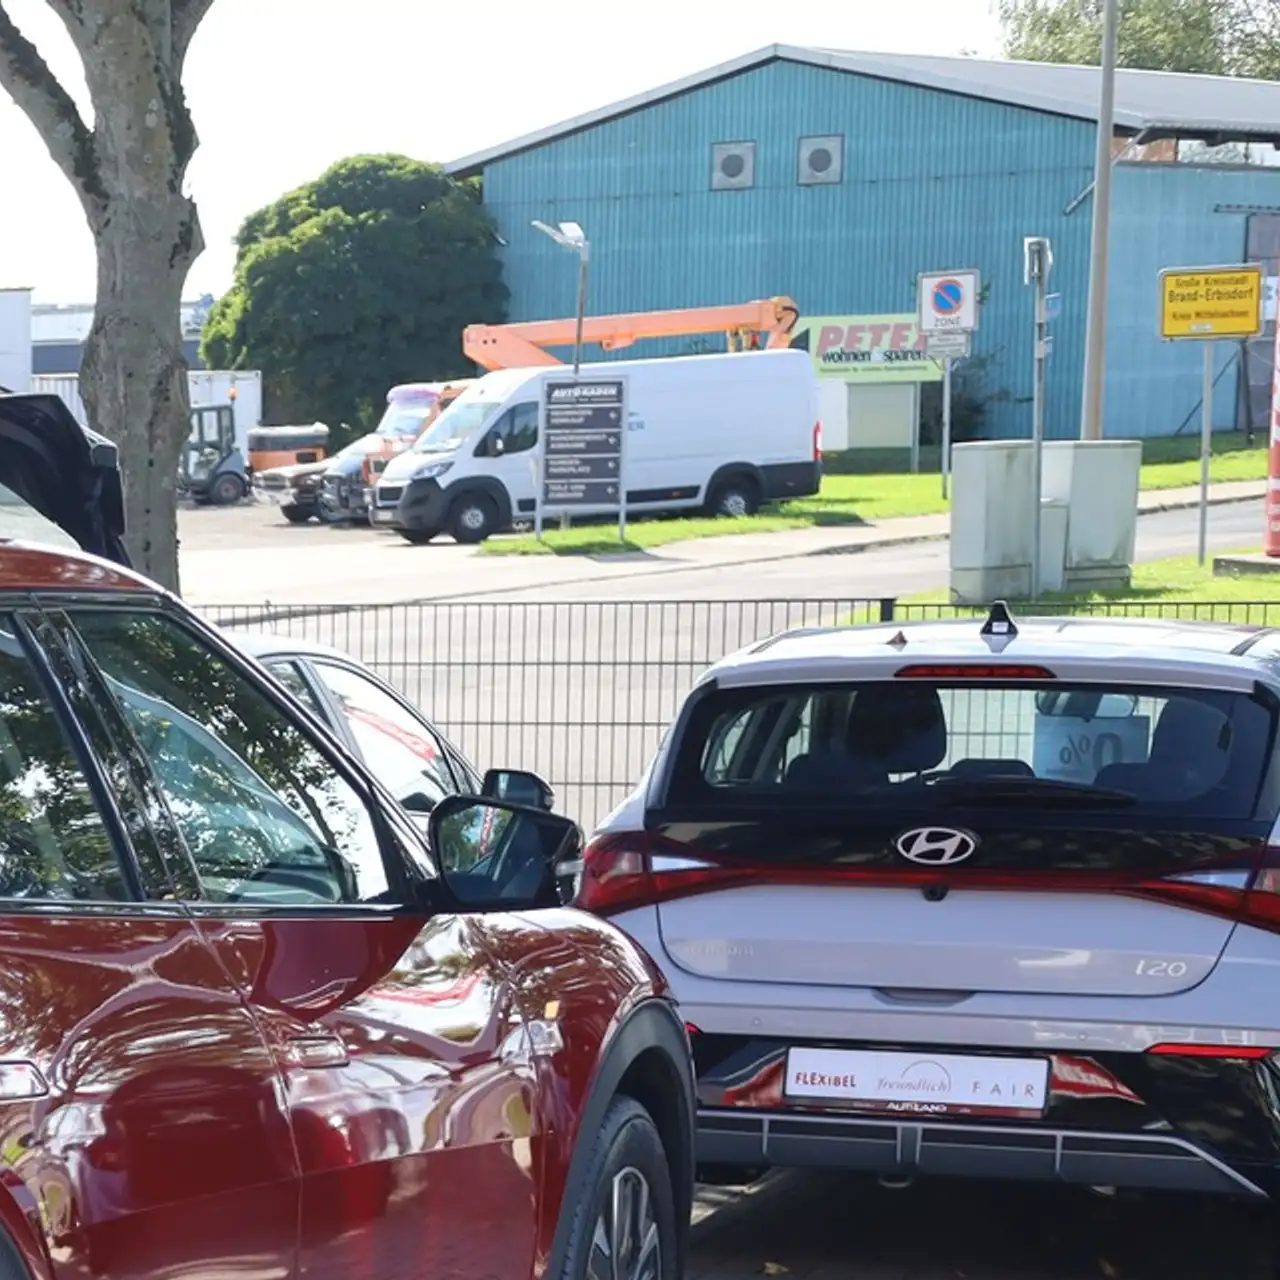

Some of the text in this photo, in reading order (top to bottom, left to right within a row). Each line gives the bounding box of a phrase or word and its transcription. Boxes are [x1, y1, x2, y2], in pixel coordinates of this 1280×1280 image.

[933, 316, 961, 327] ZONE
[822, 346, 871, 363] wohnen
[794, 1072, 1035, 1098] FLEXIBEL freundlich FAIR
